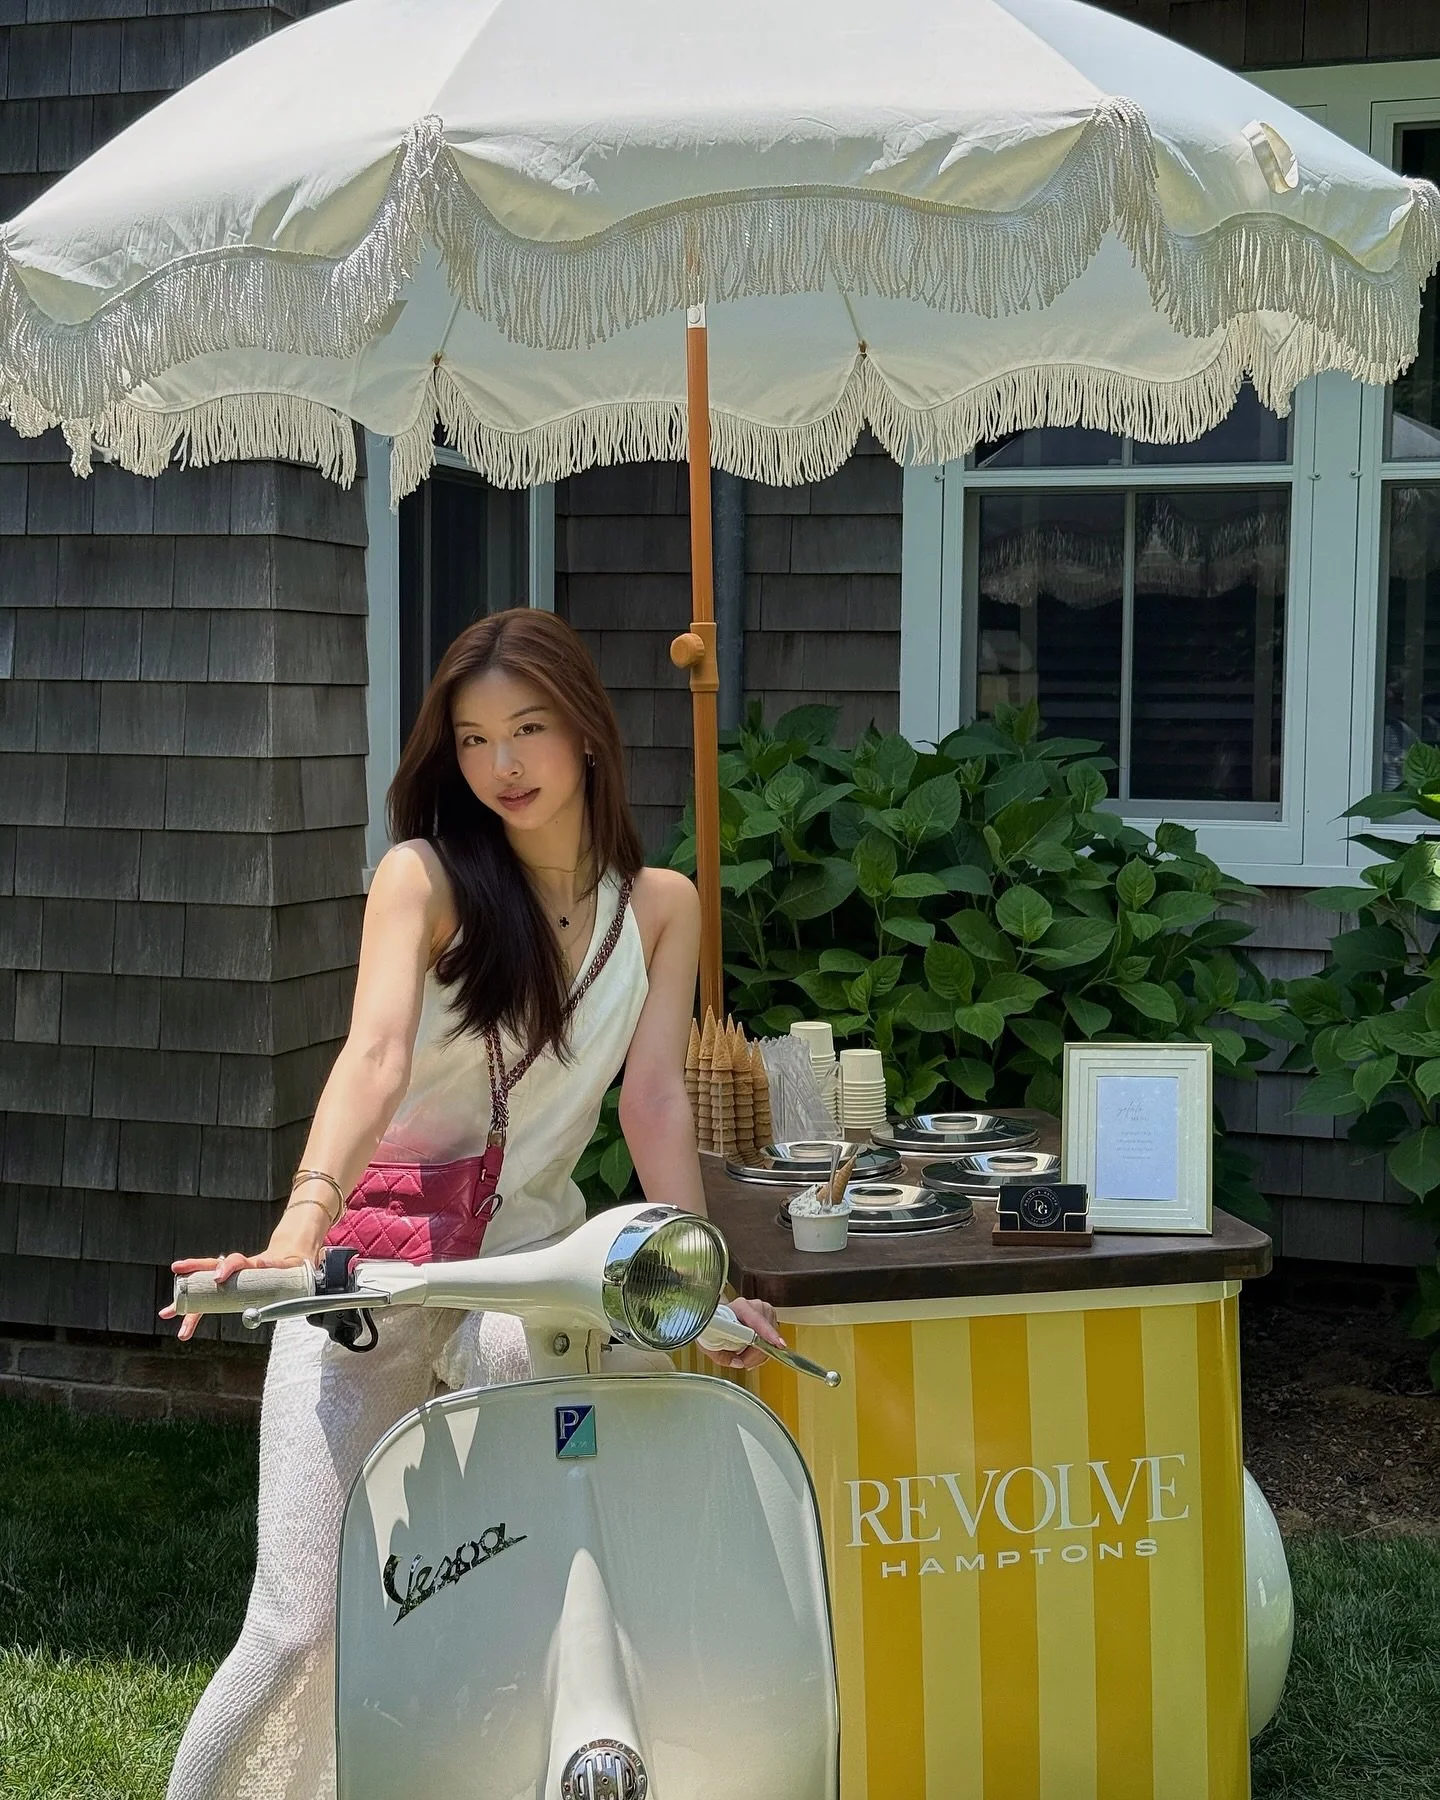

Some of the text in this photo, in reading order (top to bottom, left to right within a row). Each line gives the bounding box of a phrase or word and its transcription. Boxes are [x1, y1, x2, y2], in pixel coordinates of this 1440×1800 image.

[558, 1409, 580, 1440] P
[843, 1453, 1189, 1548] REVOLVE
[383, 1522, 528, 1626] Vespa
[881, 1538, 1158, 1578] HAMPTONS
